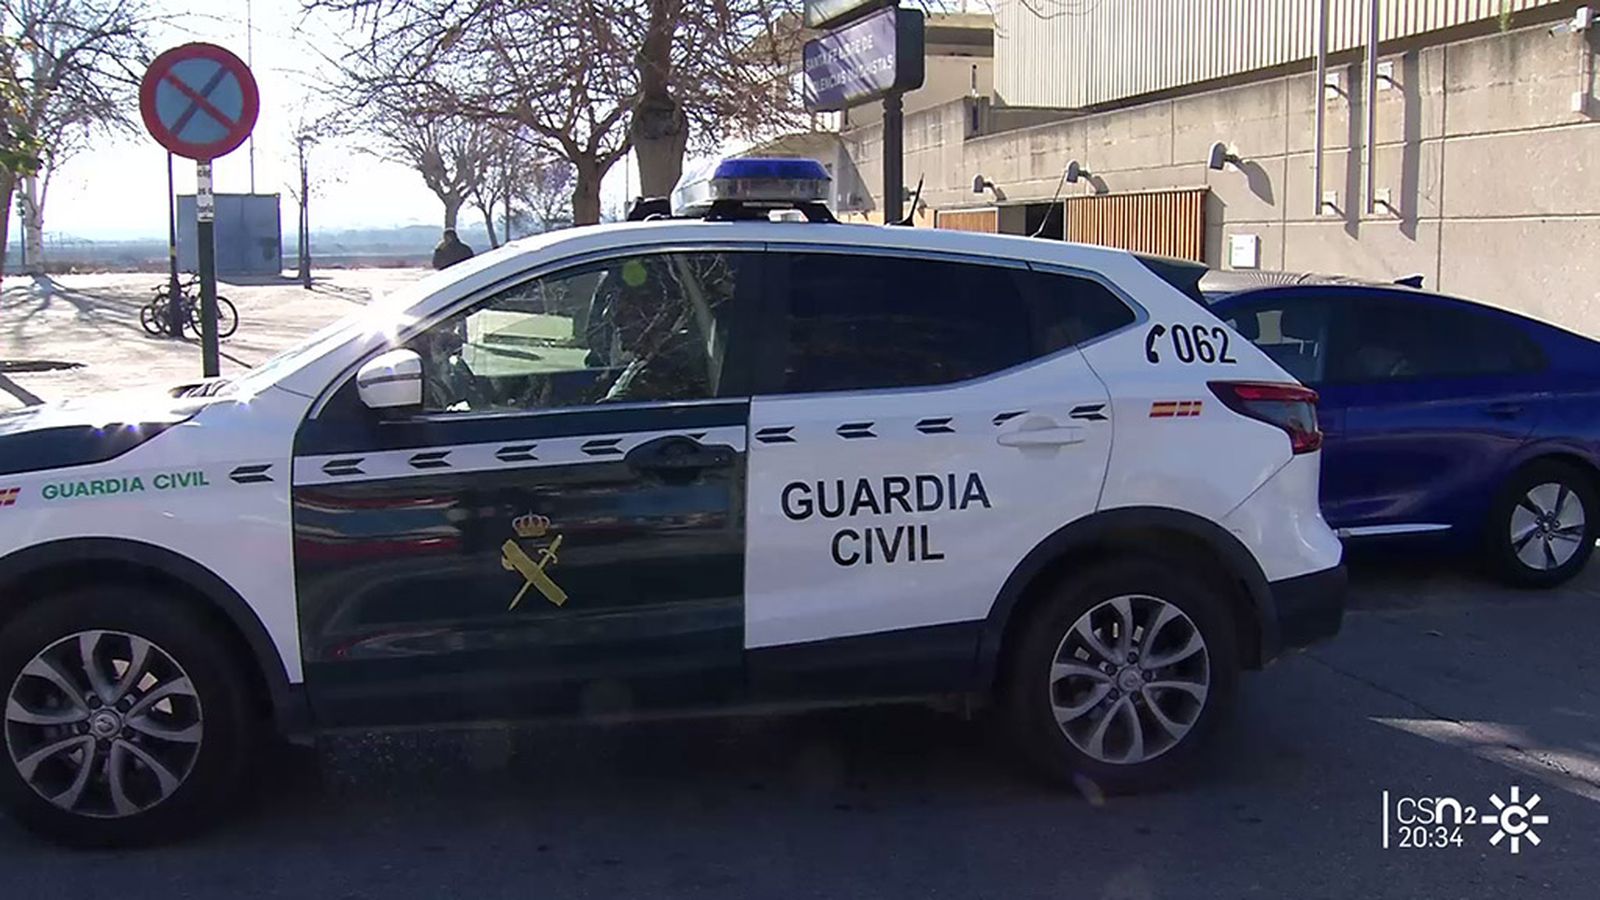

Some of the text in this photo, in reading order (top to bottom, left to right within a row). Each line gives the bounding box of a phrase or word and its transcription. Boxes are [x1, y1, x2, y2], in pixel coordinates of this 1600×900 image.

[1171, 324, 1237, 364] 062
[42, 471, 210, 500] GUARDIA CIVIL
[781, 472, 992, 521] GUARDIA
[832, 525, 945, 566] CIVIL
